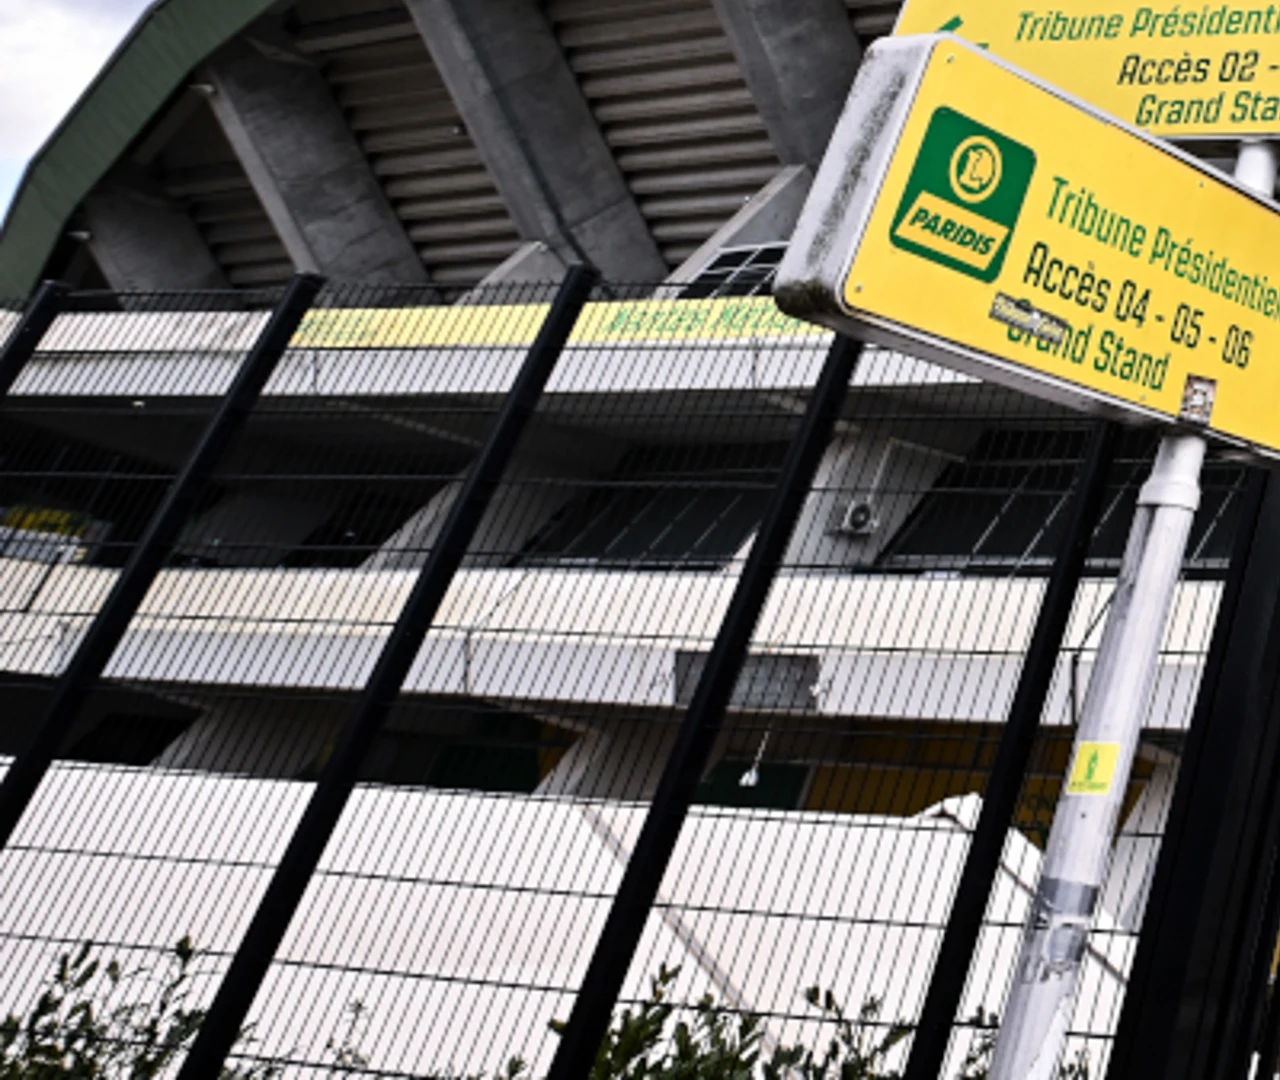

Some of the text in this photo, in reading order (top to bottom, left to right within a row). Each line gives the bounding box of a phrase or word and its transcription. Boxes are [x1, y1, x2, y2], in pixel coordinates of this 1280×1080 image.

[1015, 11, 1123, 41] Tribune
[1117, 52, 1210, 85] Accès
[1218, 51, 1259, 82] 02
[1136, 93, 1225, 126] Grand
[908, 207, 996, 256] PARIDIS
[1047, 176, 1146, 258] Tribune
[1023, 241, 1111, 313] Accès
[1115, 279, 1151, 327] 04
[1171, 302, 1205, 349] 05
[1222, 324, 1254, 370] 06
[1094, 329, 1171, 391] Stand
